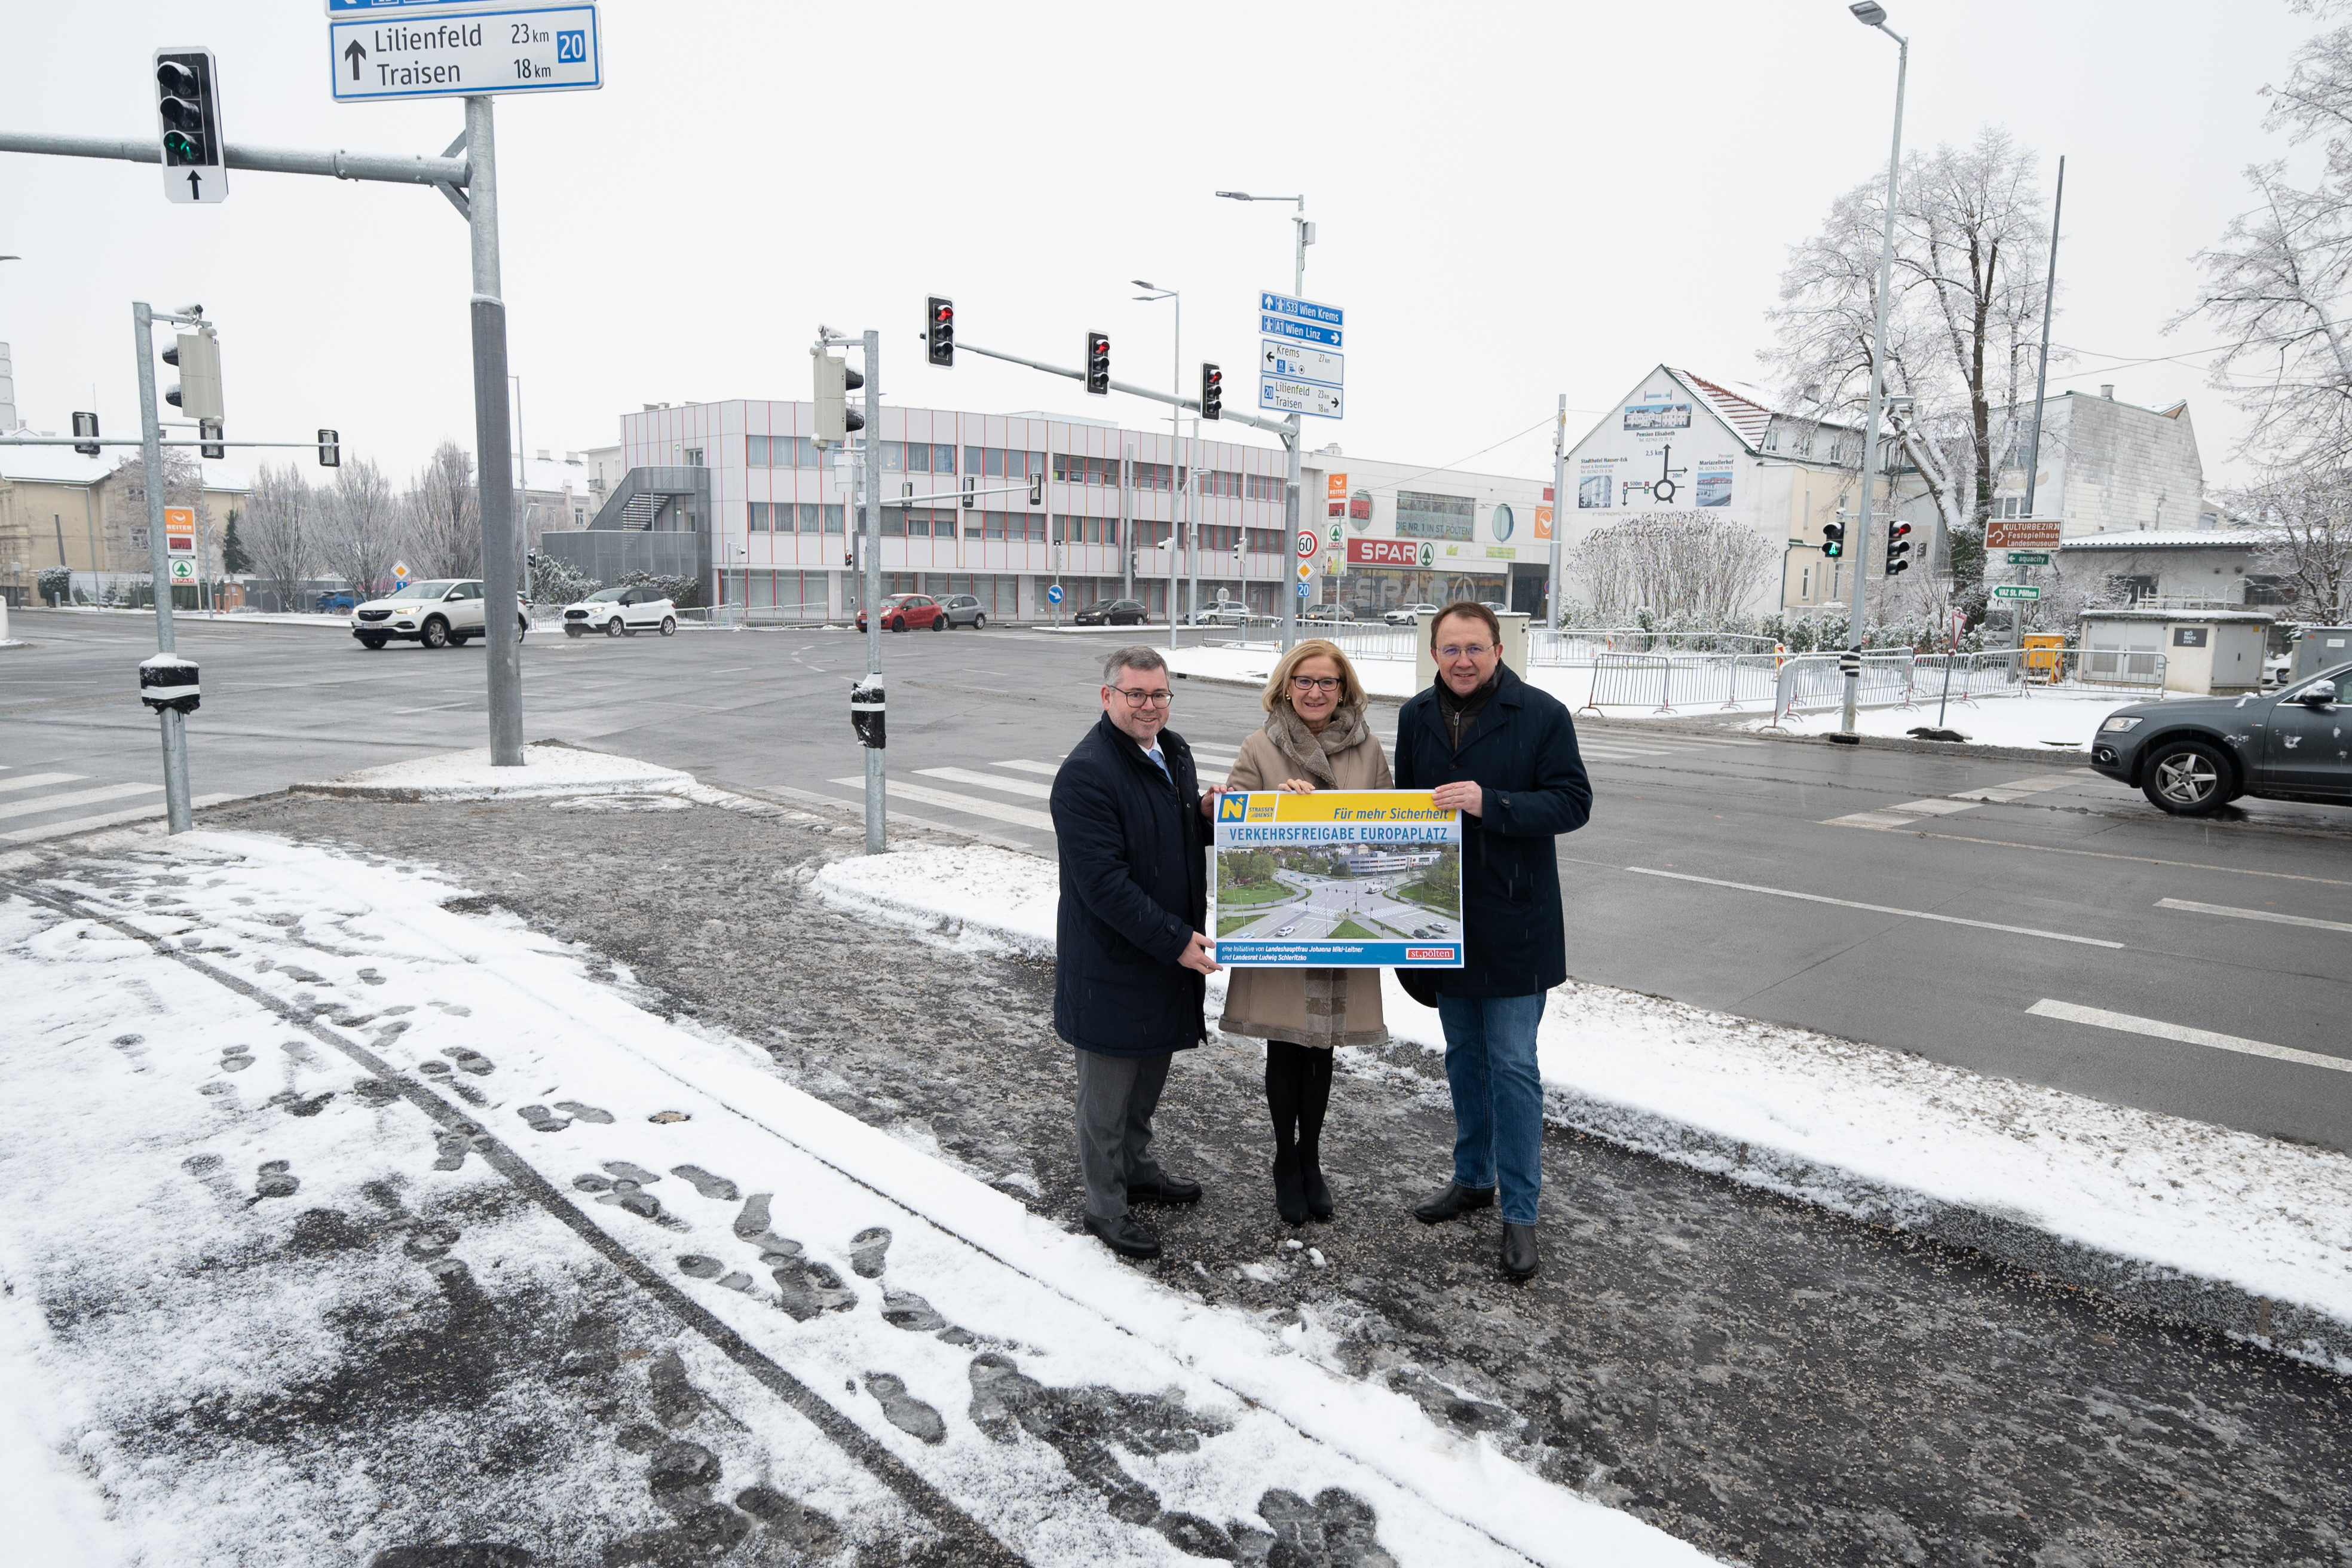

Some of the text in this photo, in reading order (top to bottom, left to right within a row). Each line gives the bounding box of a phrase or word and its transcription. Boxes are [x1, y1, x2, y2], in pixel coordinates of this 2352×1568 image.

[375, 23, 549, 52] Lilienfeld 23 km
[559, 34, 583, 59] 20
[377, 59, 551, 85] Traisen 18 km
[1287, 301, 1339, 322] S33 Wien Krems
[1276, 321, 1321, 339] A1 Wien Linz
[1277, 344, 1300, 358] Krems
[1319, 354, 1325, 363] 27
[1265, 387, 1273, 398] 20
[1276, 381, 1310, 396] Lilienfeld
[1318, 390, 1324, 399] 23
[1276, 396, 1302, 409] Traisen
[1318, 404, 1324, 412] 18
[1350, 510, 1369, 519] PUR
[1396, 522, 1407, 531] DIE
[1408, 522, 1420, 531] NR.
[1427, 524, 1434, 532] IN
[1435, 525, 1444, 534] ST.
[1446, 524, 1472, 535] PÖLTEN!
[1298, 537, 1312, 552] 60
[1361, 543, 1416, 562] SPAR
[2019, 555, 2045, 564] aquacity
[1298, 584, 1309, 596] 20
[2019, 589, 2036, 597] Pölten
[1334, 807, 1448, 819] Für mehr Sicherheit
[1230, 828, 1447, 841] VERKEHRSFREIGABE EUROPAPLATZ
[1411, 950, 1450, 958] st.pölten
